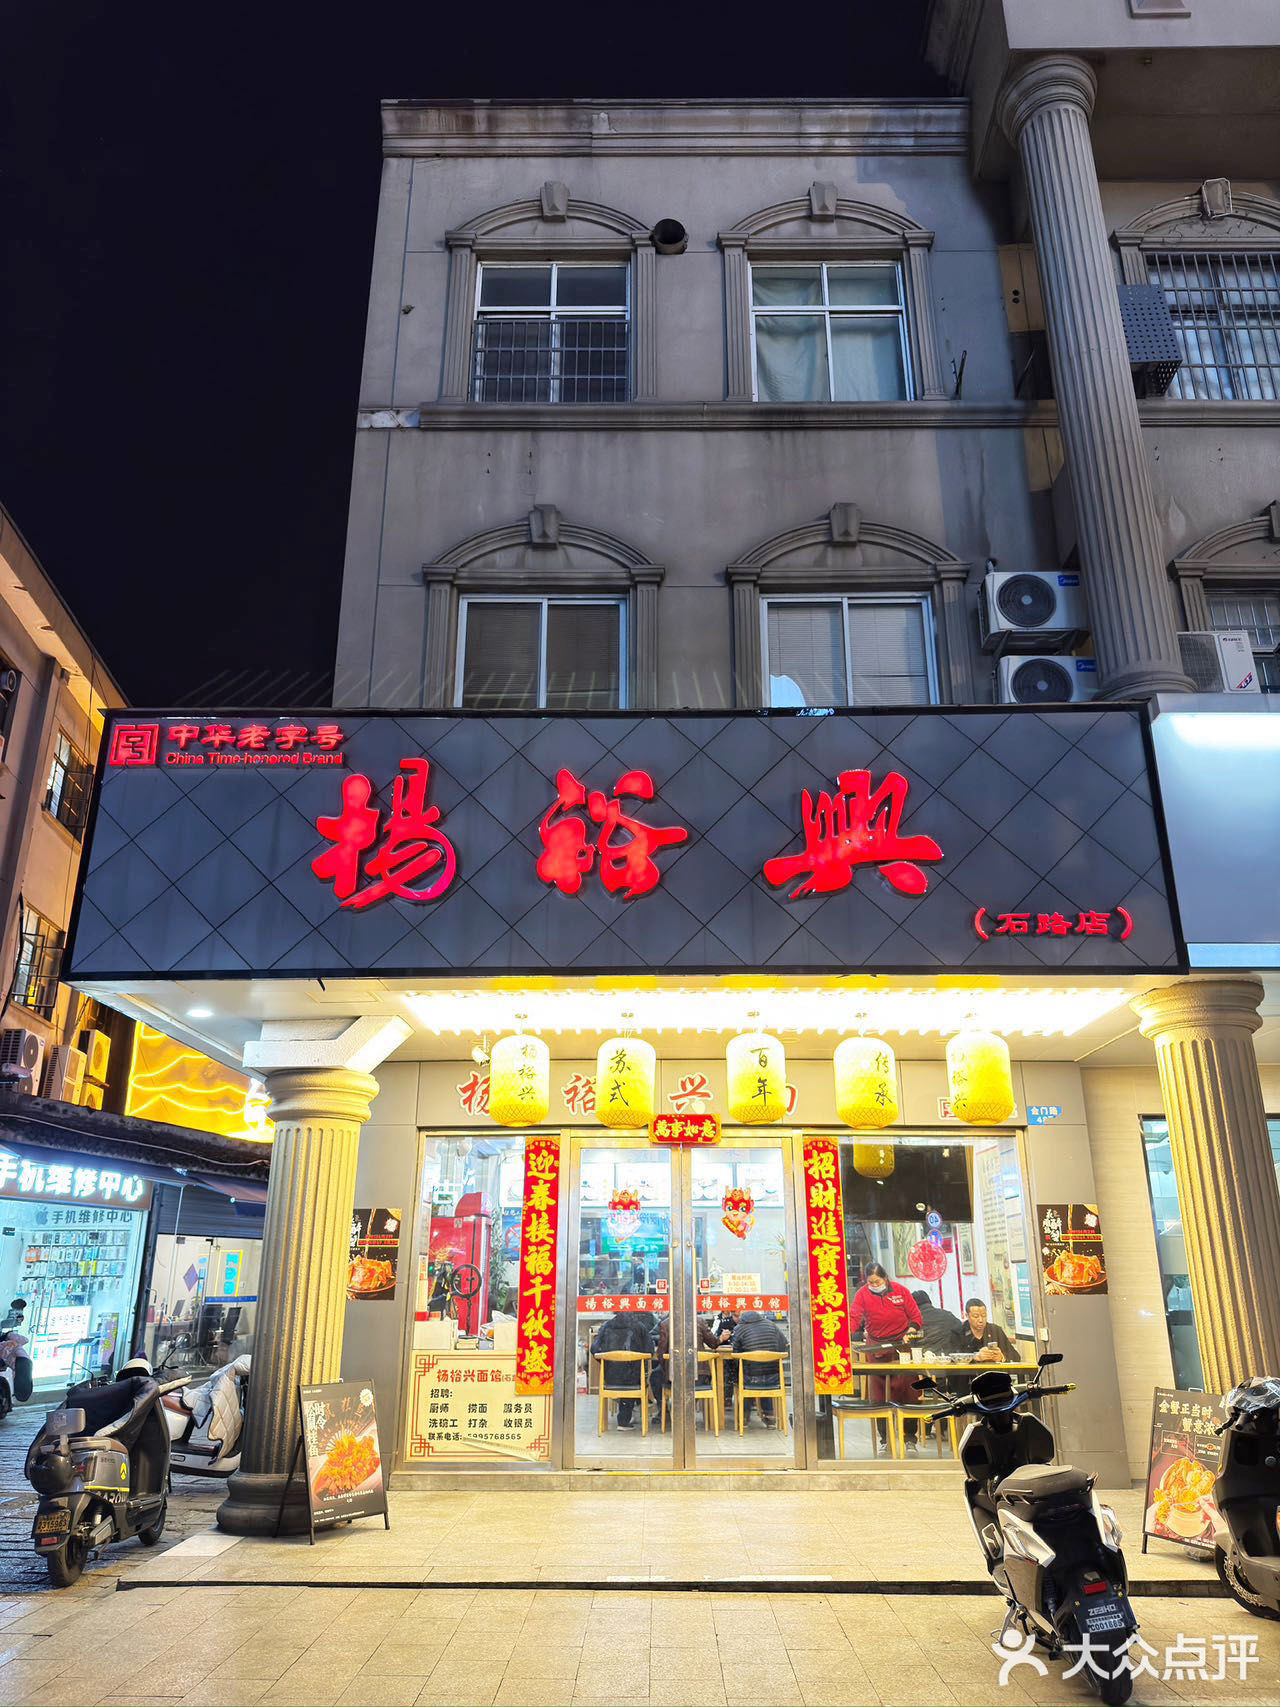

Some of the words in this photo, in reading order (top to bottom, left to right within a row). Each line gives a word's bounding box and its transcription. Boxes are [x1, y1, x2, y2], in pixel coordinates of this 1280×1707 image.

[168, 724, 344, 750] 中华老字号
[166, 752, 204, 764] China
[207, 752, 299, 764] Time-honored
[303, 752, 342, 764] Brand
[974, 906, 1133, 941] (石路店)
[750, 1047, 772, 1106] 百年
[654, 1119, 716, 1138] 萬事如意
[0, 1157, 143, 1201] 手机维修中心
[52, 1209, 133, 1225] 手机维修中心
[430, 1388, 453, 1398] 招聘:
[429, 1403, 449, 1413] 厨师
[468, 1403, 488, 1413] 捞面
[503, 1403, 533, 1413] 服务员
[1158, 1399, 1213, 1419] 金蟹正当时
[428, 1418, 458, 1428] 洗碗工
[468, 1418, 488, 1428] 打杂
[503, 1418, 533, 1428] 收银员
[1182, 1417, 1222, 1436] 蟹意浓
[428, 1432, 463, 1441] 联系电话:
